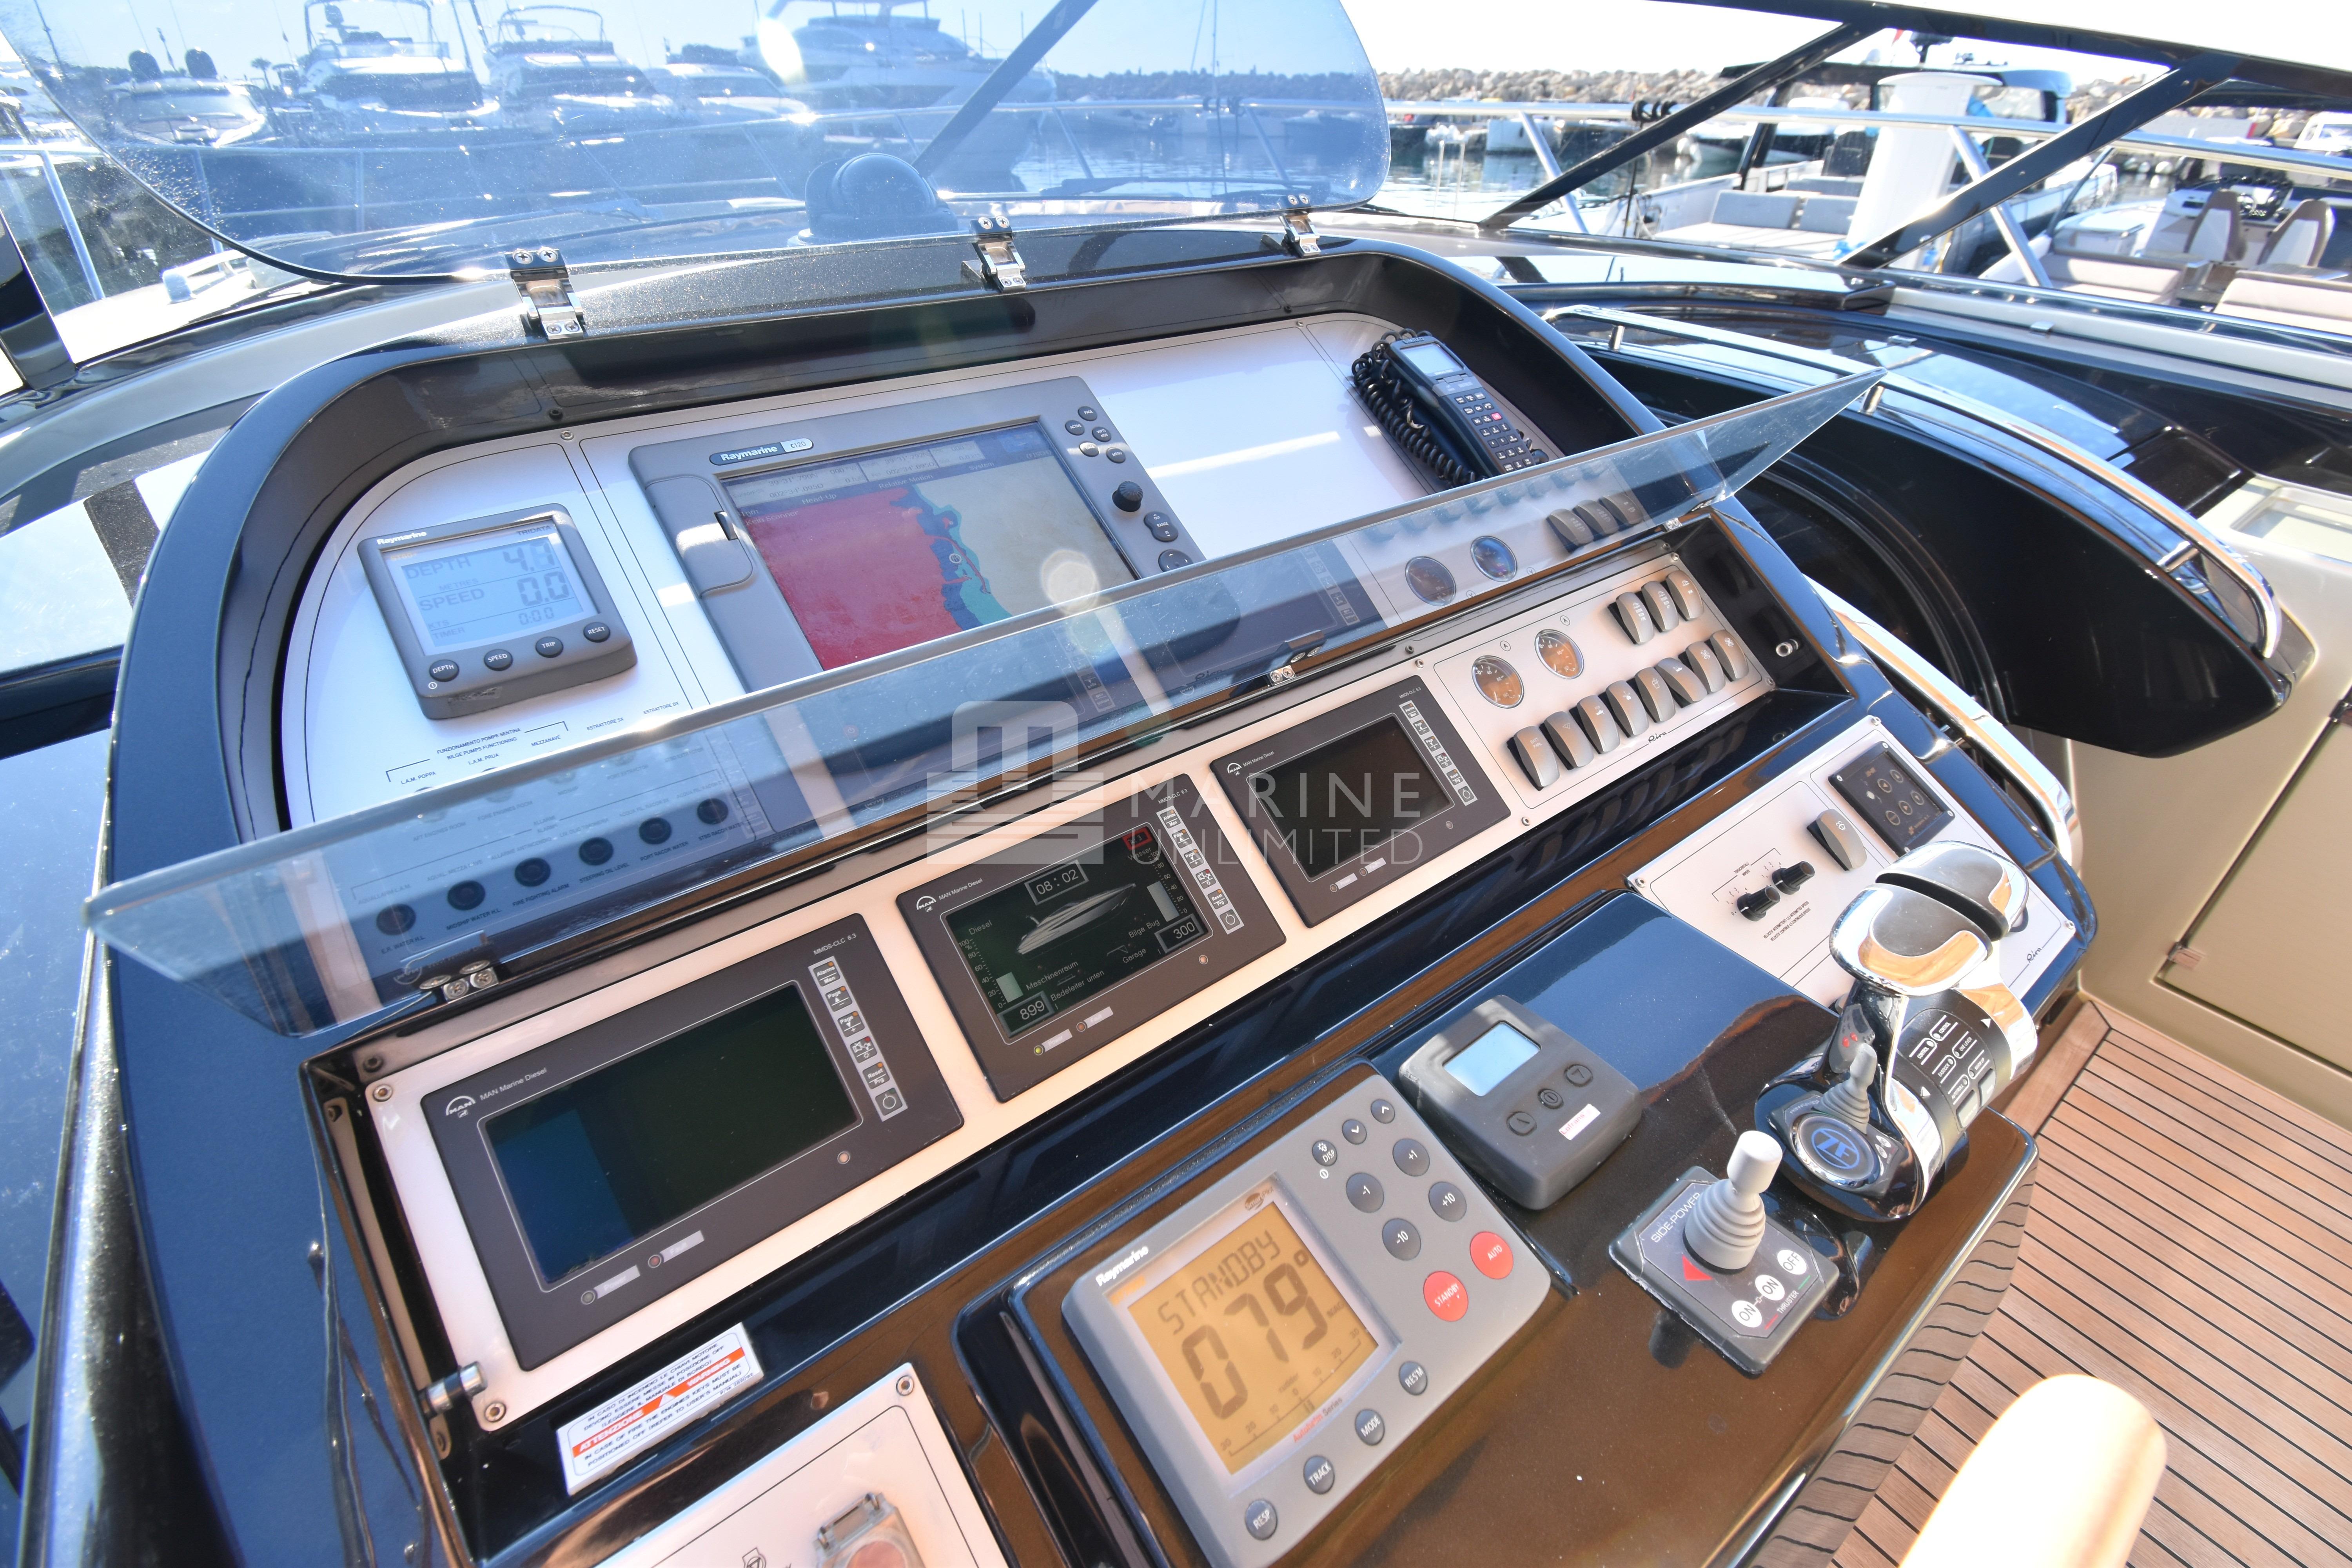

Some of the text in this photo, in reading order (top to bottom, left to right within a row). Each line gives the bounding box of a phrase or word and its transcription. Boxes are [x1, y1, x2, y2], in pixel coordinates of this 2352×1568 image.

[720, 446, 778, 461] Raymarine
[969, 462, 994, 470] System
[879, 474, 933, 490] Relative Motion
[802, 493, 837, 505] Head-Up
[745, 510, 799, 526] Kein Scanner
[376, 530, 427, 545] Raymarine
[517, 525, 552, 536] TRIDATA
[404, 556, 471, 579] DEPTH
[439, 578, 479, 591] METRES
[516, 571, 570, 607] 0.0
[419, 588, 485, 612] SPEED
[429, 619, 450, 630] KTS
[587, 626, 605, 635] RESET
[432, 627, 465, 640] TIMER
[541, 641, 555, 649] TRIP
[488, 653, 508, 663] SPEED
[432, 664, 454, 674] DEPTH
[643, 704, 673, 715] ESTRATTORE
[586, 719, 617, 731] ESTRATTORE
[437, 728, 521, 754] FUNZIONAMENTO POMPE SENTINA
[531, 735, 561, 746] MEZZANAVE
[1648, 731, 1667, 744] Riva
[447, 737, 517, 760] BILGE PUMPS FUNCTIONING
[418, 771, 436, 780] POPPA
[1158, 792, 1181, 804] MMDS-CLC
[672, 841, 689, 850] WATER
[579, 870, 605, 883] STEERING
[615, 863, 630, 871] LEVEL
[513, 883, 570, 907] FIRE FIGHTING ALARM
[939, 878, 983, 900] MAN Marine Diesel
[446, 912, 491, 931] MIDSHIP WATER
[969, 920, 993, 935] Diesel
[1128, 920, 1160, 938] Bilge Bug
[1173, 921, 1195, 939] 300
[394, 939, 414, 950] WATER
[813, 933, 857, 955] MMDS-CLC 6.3
[1122, 948, 1147, 964] Garage
[2027, 948, 2042, 963] Riva
[817, 965, 835, 977] Alarms
[1025, 960, 1078, 991] Maschinenraum
[987, 989, 996, 998] 20
[1050, 970, 1105, 1002] Badeleiter unten
[827, 990, 841, 999] Page
[1019, 1000, 1045, 1020] 899
[840, 1016, 853, 1025] Page
[1938, 1022, 1951, 1034] CONTROL
[1964, 1036, 1973, 1047] LEVER
[1916, 1047, 1929, 1059] CONTROL
[867, 1068, 883, 1079] Reset
[874, 1076, 884, 1085] Prg
[480, 1067, 547, 1100] MAN Marine Diesel
[1323, 1149, 1335, 1163] DISP
[1408, 1150, 1418, 1160] +1
[1362, 1185, 1370, 1195] -1
[1442, 1192, 1456, 1207] +10
[1395, 1230, 1409, 1244] -10
[1487, 1245, 1503, 1261] AUTO
[1096, 1246, 1149, 1286] Raymarine
[1782, 1252, 1800, 1271] OFF
[1157, 1230, 1281, 1335] STANDBY
[1762, 1278, 1779, 1295] ON
[1434, 1282, 1460, 1308] STANDBY
[1777, 1290, 1800, 1314] THRUSTER
[1326, 1301, 1345, 1318] MAG
[1739, 1303, 1755, 1322] ON
[597, 1403, 616, 1416] CASO
[627, 1379, 658, 1398] INCENDIO
[670, 1360, 690, 1373] CHIAVI
[692, 1343, 718, 1361] MOTORE
[686, 1358, 731, 1387] WARNING
[733, 1373, 754, 1386] 282092
[1404, 1367, 1424, 1387] RES'M
[584, 1345, 725, 1431] DEVONO ESSERE MESSE POSIZIONE OFF
[1278, 1373, 1299, 1394] rudder
[602, 1360, 712, 1428] (LEGGERE MANUALE BORDO)
[588, 1439, 631, 1466] POSITIONED
[632, 1429, 646, 1440] OFF
[648, 1413, 673, 1430] (REFER
[686, 1391, 711, 1407] USER'S
[713, 1371, 742, 1391] MANUAL)
[594, 1441, 613, 1454] CASE
[616, 1434, 625, 1442] OF
[628, 1423, 643, 1435] FIRE
[645, 1414, 659, 1423] THE
[661, 1395, 690, 1415] ENGINES
[692, 1383, 710, 1396] KEYS
[711, 1370, 730, 1383] MUST
[1293, 1397, 1343, 1443] Autohelm Series
[579, 1409, 644, 1453] ATTENZIONE
[1361, 1415, 1381, 1437] MODE
[1220, 1421, 1256, 1450] 30 20
[1308, 1462, 1331, 1486] TRACK
[1252, 1510, 1271, 1529] RESP
